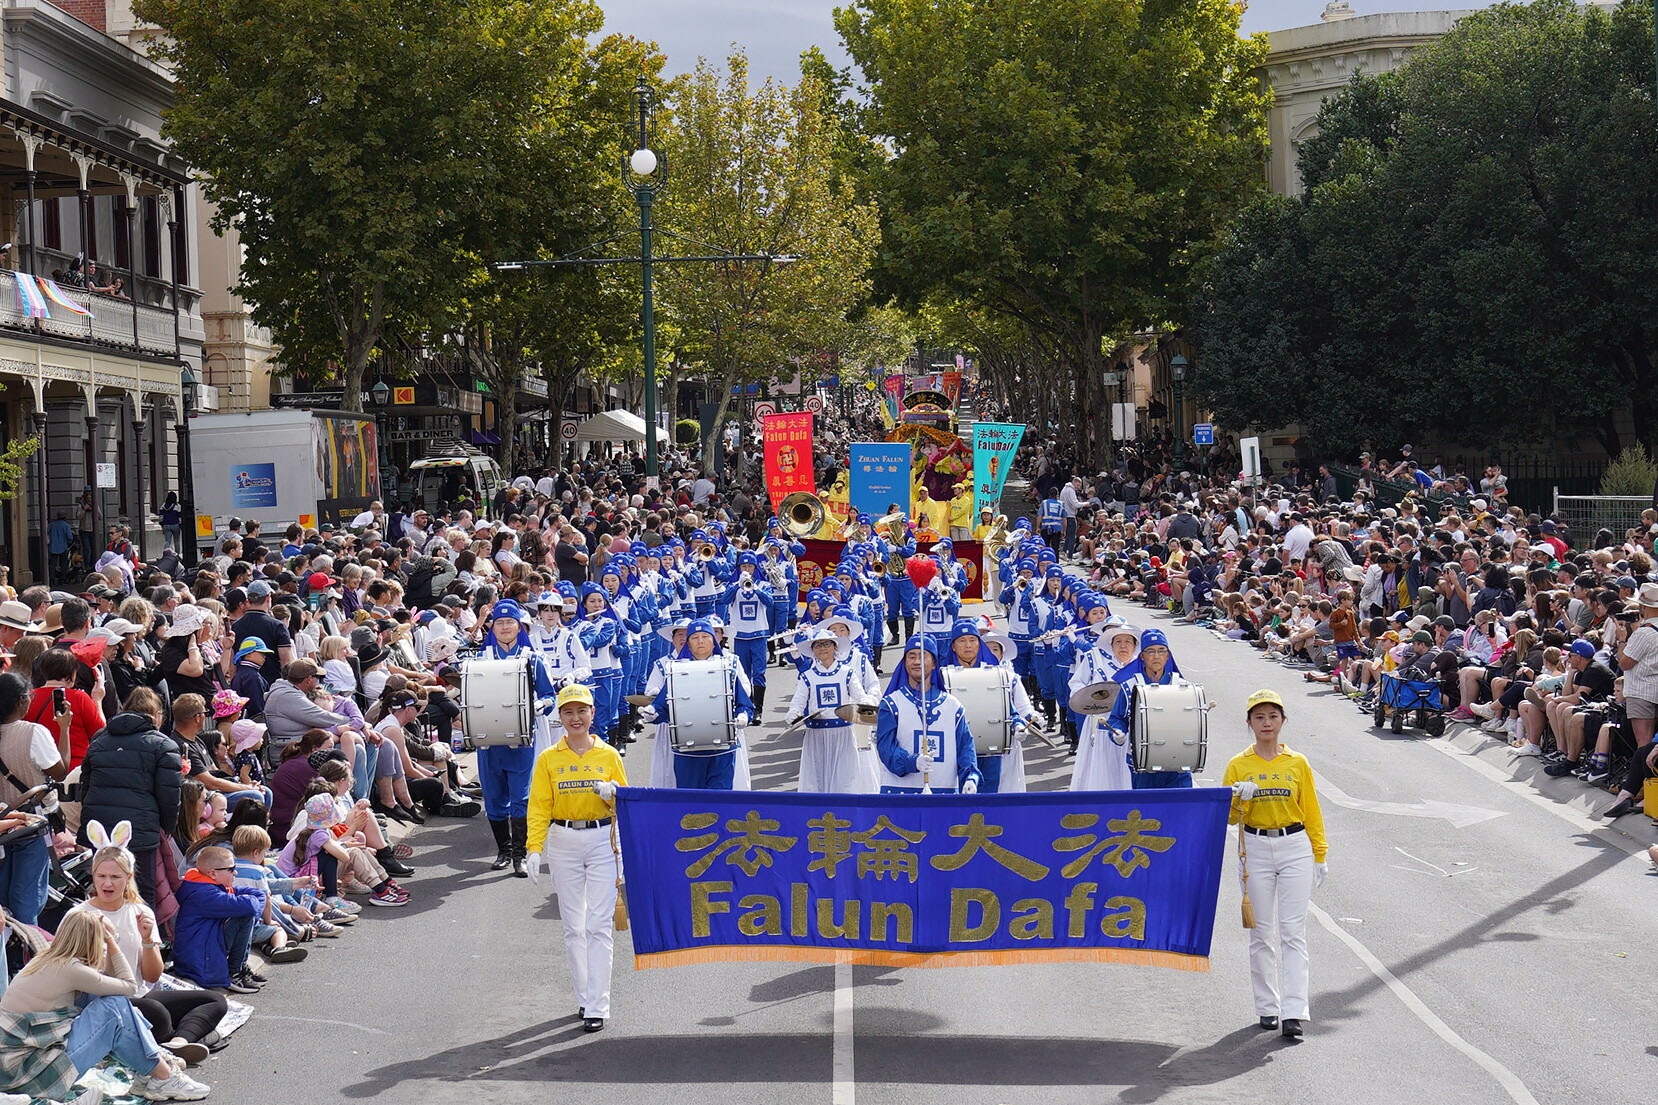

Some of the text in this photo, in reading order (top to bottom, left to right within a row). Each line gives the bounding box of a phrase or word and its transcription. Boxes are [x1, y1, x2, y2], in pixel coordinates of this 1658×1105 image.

[809, 401, 819, 409] 40
[765, 417, 808, 431] 法輪大法
[391, 432, 411, 440] BAR
[423, 430, 454, 438] DINER
[766, 431, 787, 442] Falun
[977, 429, 1019, 440] 法輪大法
[882, 455, 904, 463] FALUN
[822, 689, 835, 702] 樂
[559, 781, 582, 789] FALUN
[674, 810, 1177, 884] 法輪大法
[689, 880, 1147, 944] Falun Dafa
